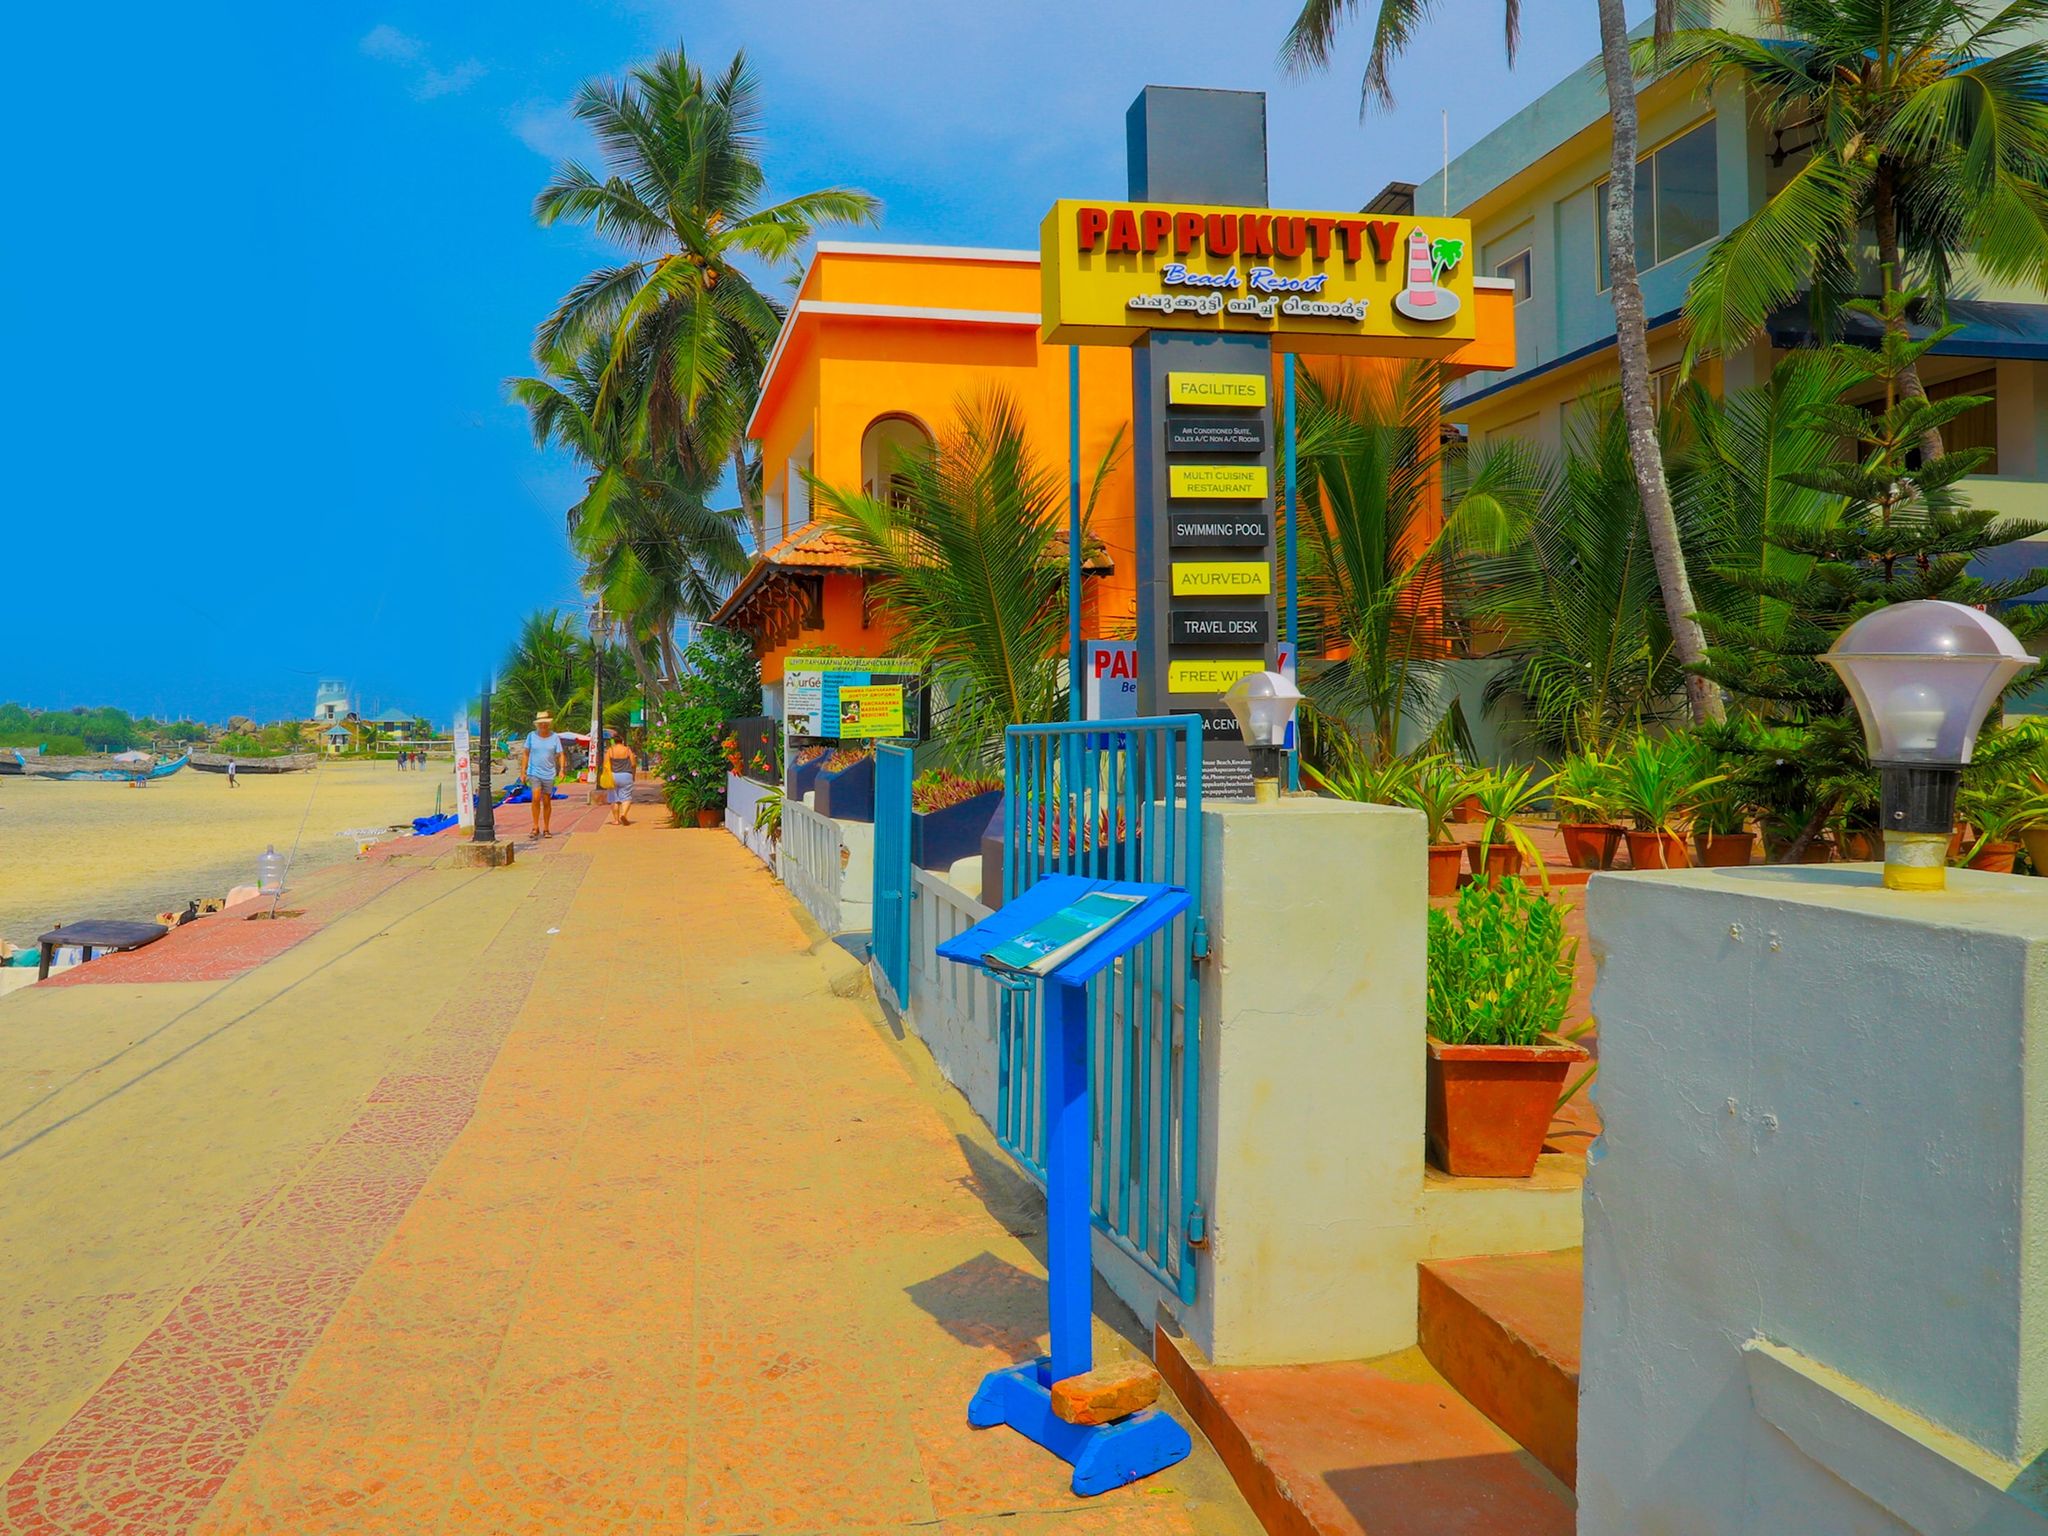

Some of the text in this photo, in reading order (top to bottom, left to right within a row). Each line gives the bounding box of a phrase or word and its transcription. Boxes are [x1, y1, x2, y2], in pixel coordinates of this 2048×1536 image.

[1077, 207, 1400, 264] PAPPUKUTTY
[1164, 263, 1328, 293] Beach Resort
[1181, 383, 1257, 396] FACILITIES
[1183, 472, 1254, 480] MULTI CUISINE
[1187, 484, 1252, 492] RESTAURANT
[1177, 524, 1265, 536] SWIMMING POOL
[1181, 573, 1262, 584] AYURVEDA
[1184, 621, 1258, 633] TRAVEL DESK
[1180, 671, 1217, 682] FREE
